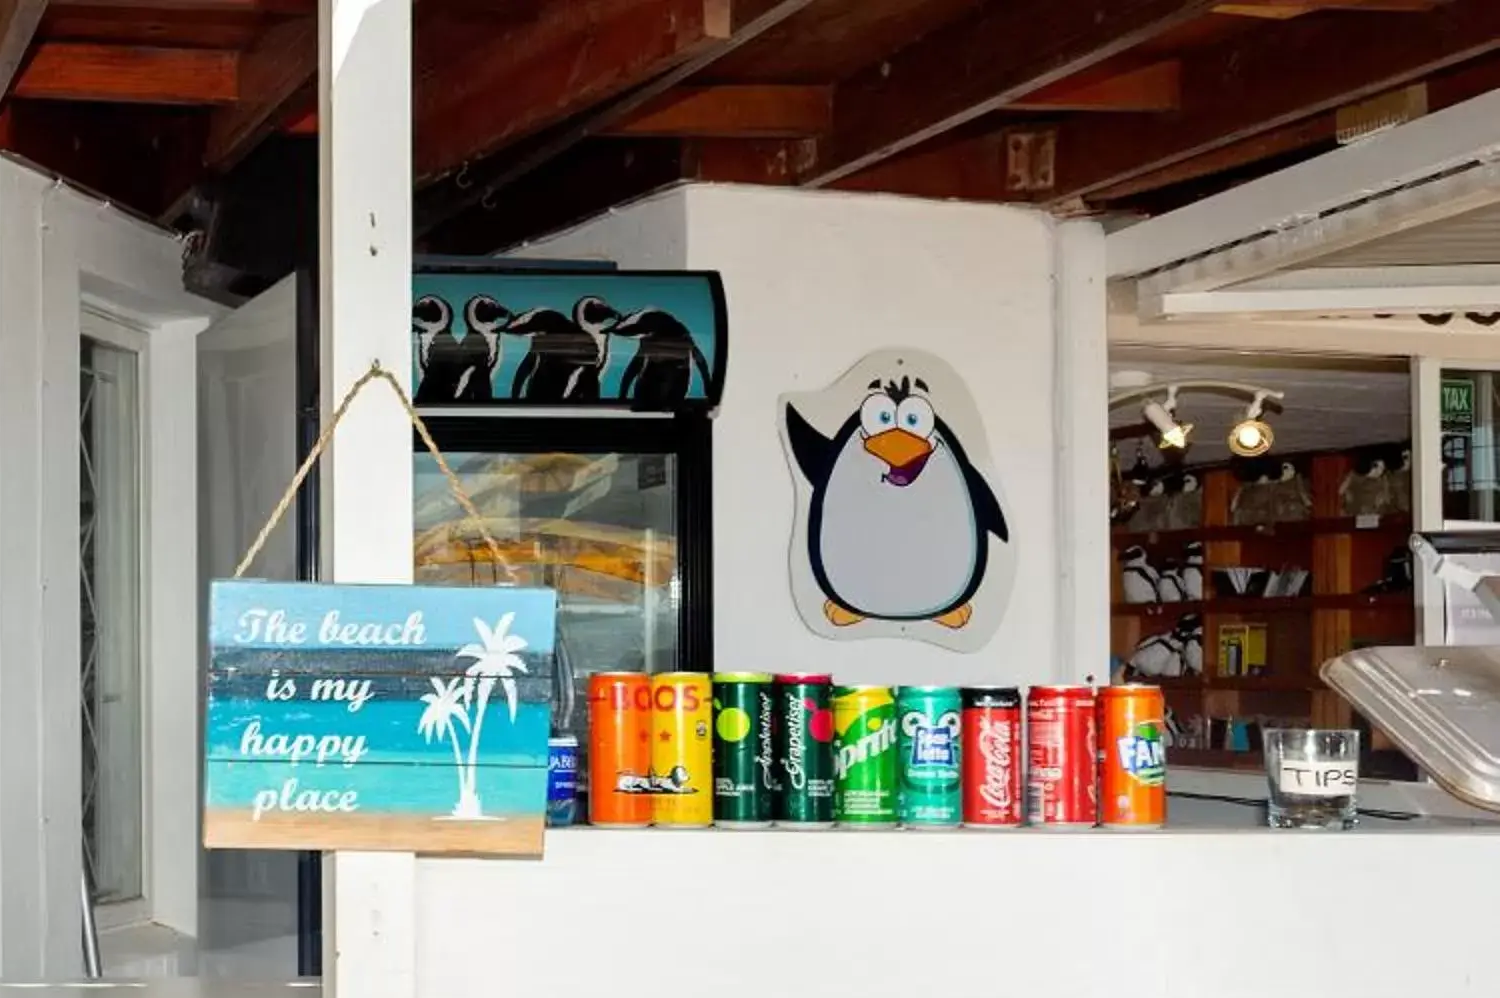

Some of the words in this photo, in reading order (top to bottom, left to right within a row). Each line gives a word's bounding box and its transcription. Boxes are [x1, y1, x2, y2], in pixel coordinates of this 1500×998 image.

[1443, 387, 1469, 411] TAX
[234, 608, 308, 645] The
[317, 609, 428, 646] beach
[265, 669, 297, 701] is
[310, 679, 375, 713] my
[239, 719, 369, 768] happy
[780, 691, 807, 790] Grapetiser
[1283, 767, 1356, 788] TIPS
[252, 778, 361, 822] place
